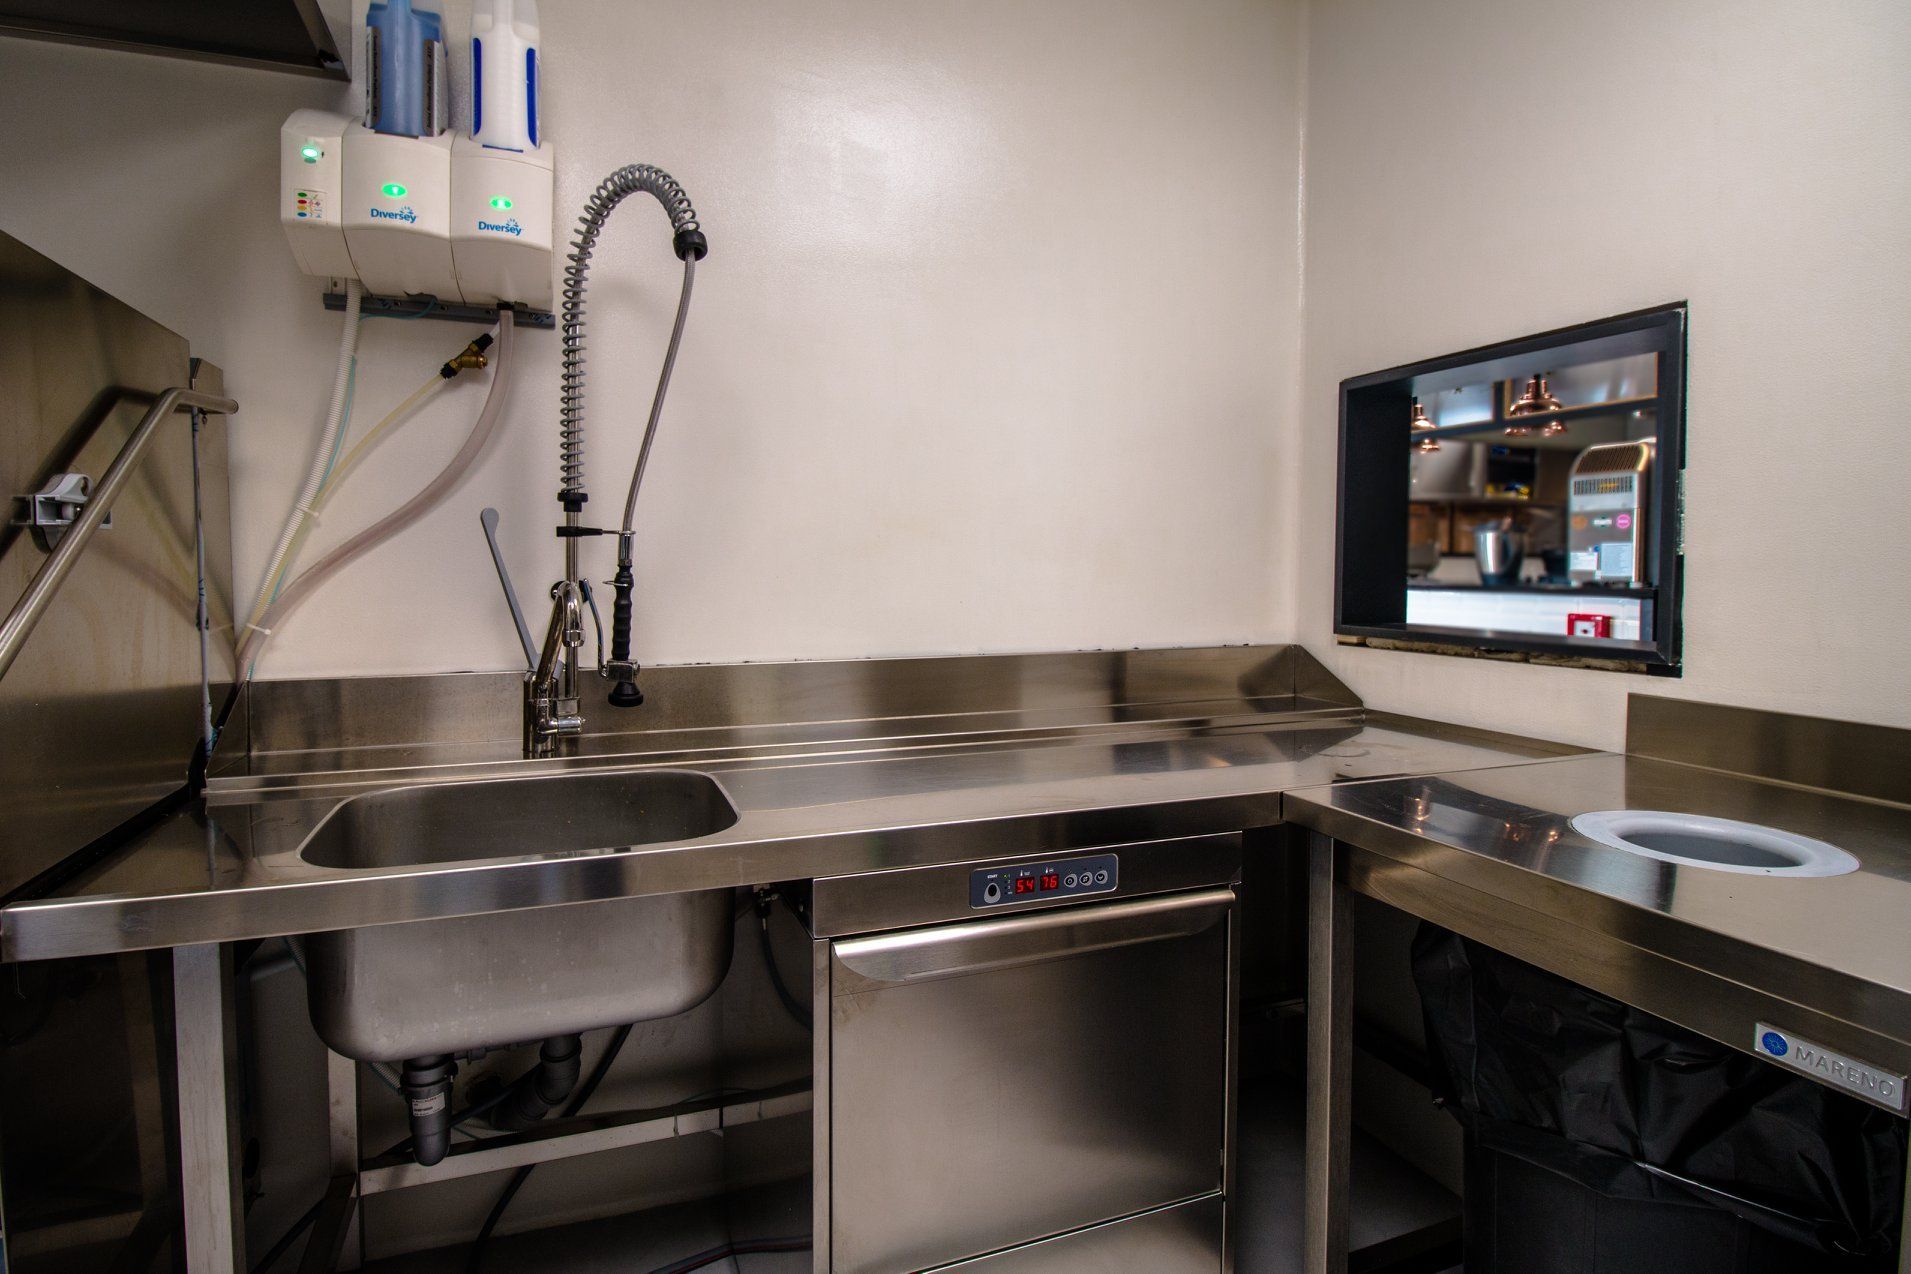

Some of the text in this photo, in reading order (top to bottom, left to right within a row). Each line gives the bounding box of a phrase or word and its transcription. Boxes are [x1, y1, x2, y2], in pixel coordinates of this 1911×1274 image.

[370, 208, 417, 224] Diversey
[478, 221, 522, 236] Diversey
[1017, 875, 1057, 893] 54 76
[1795, 1046, 1896, 1098] MARENO
